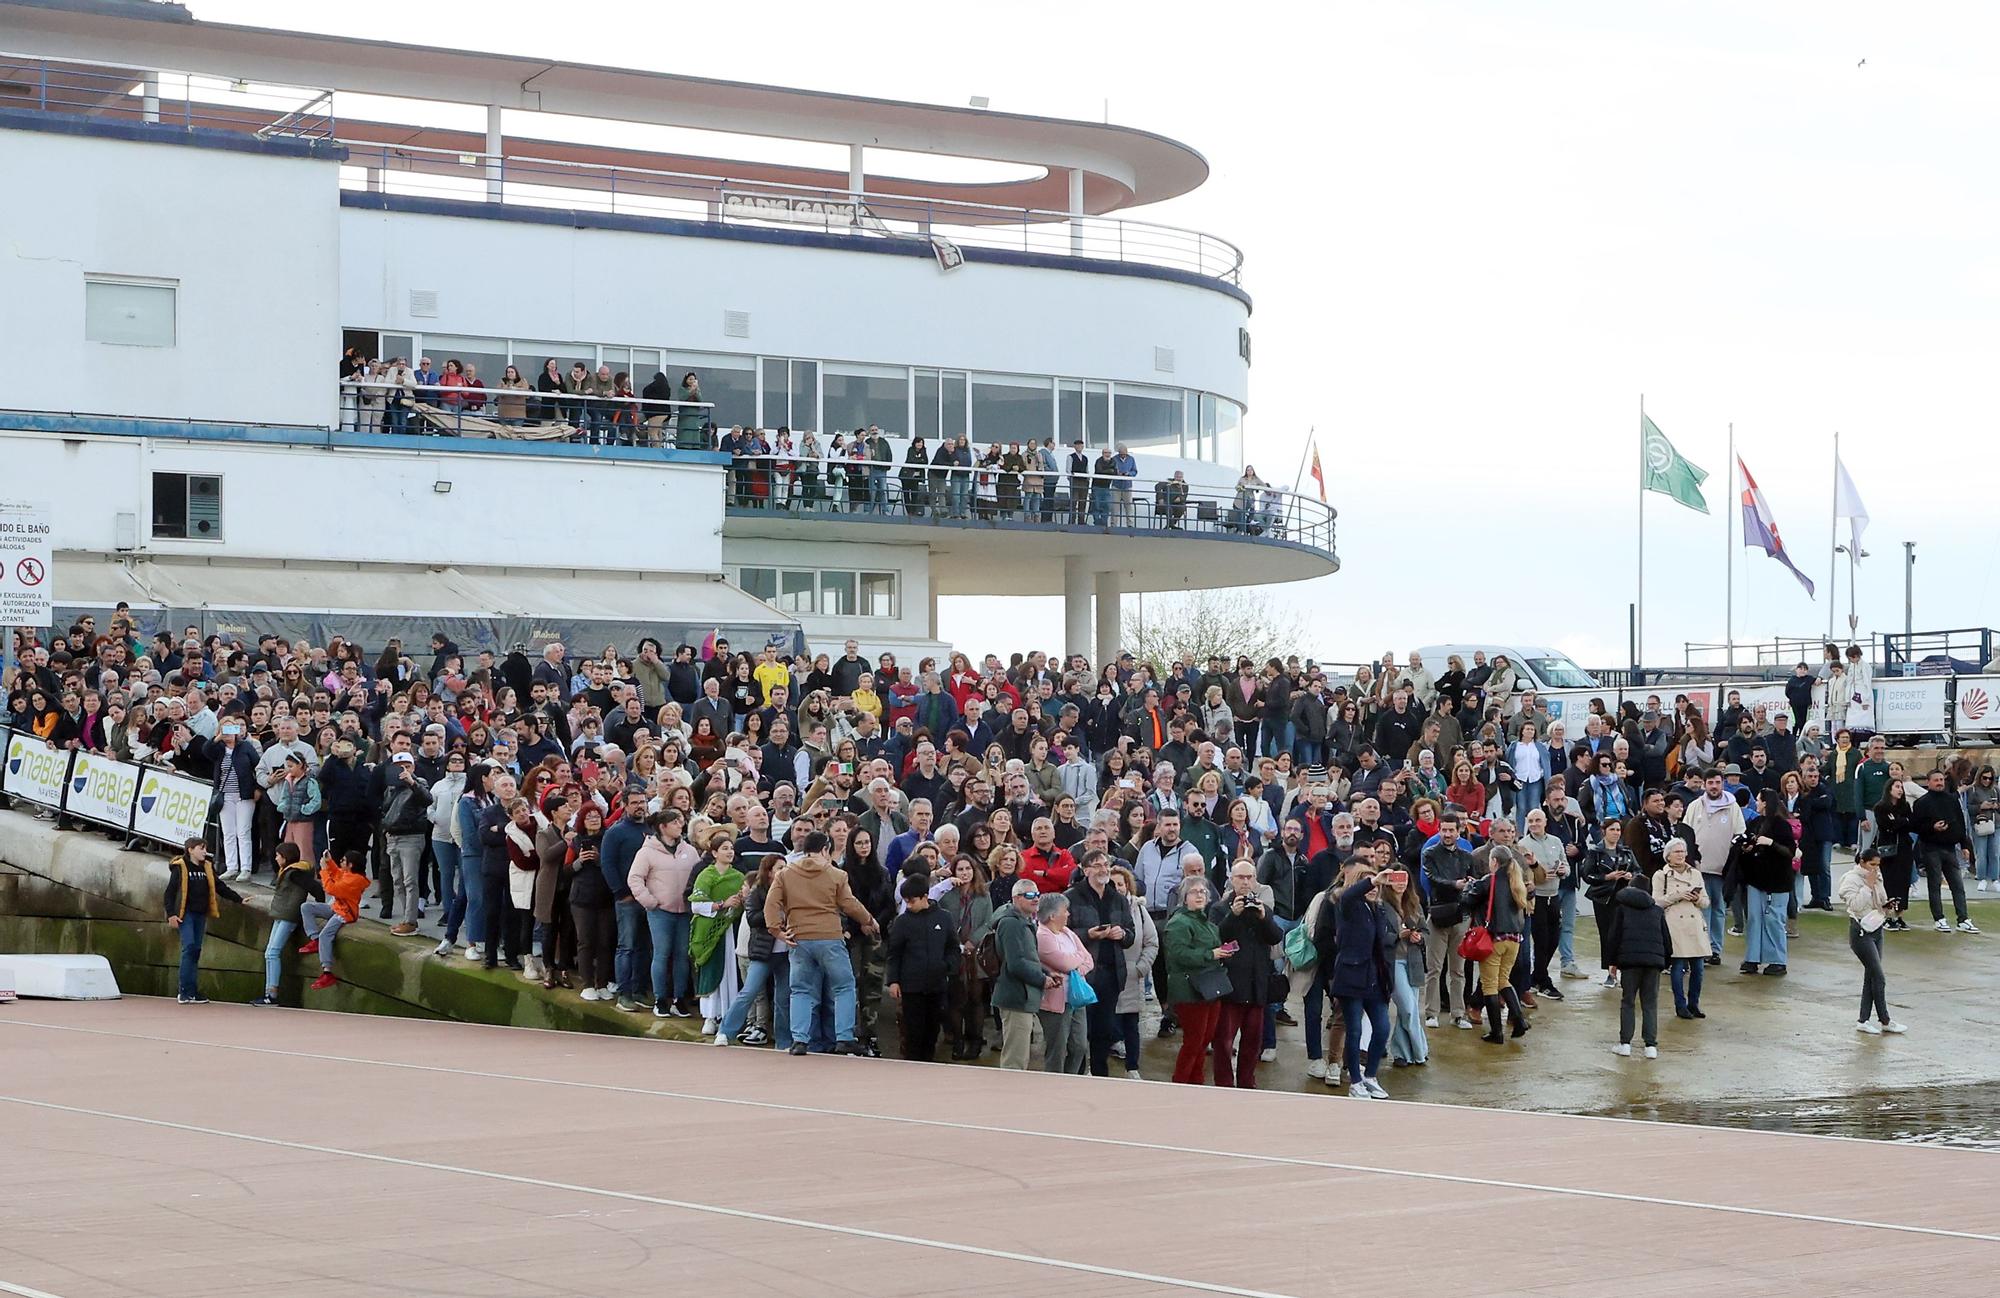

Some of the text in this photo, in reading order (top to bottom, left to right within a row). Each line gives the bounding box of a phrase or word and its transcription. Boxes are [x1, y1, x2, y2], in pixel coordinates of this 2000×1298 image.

[16, 524, 26, 533] EL
[28, 522, 50, 534] BAÑO
[1889, 689, 1927, 700] DEPORTE
[1888, 702, 1922, 711] GALEGO
[106, 805, 129, 819] NAVIERA
